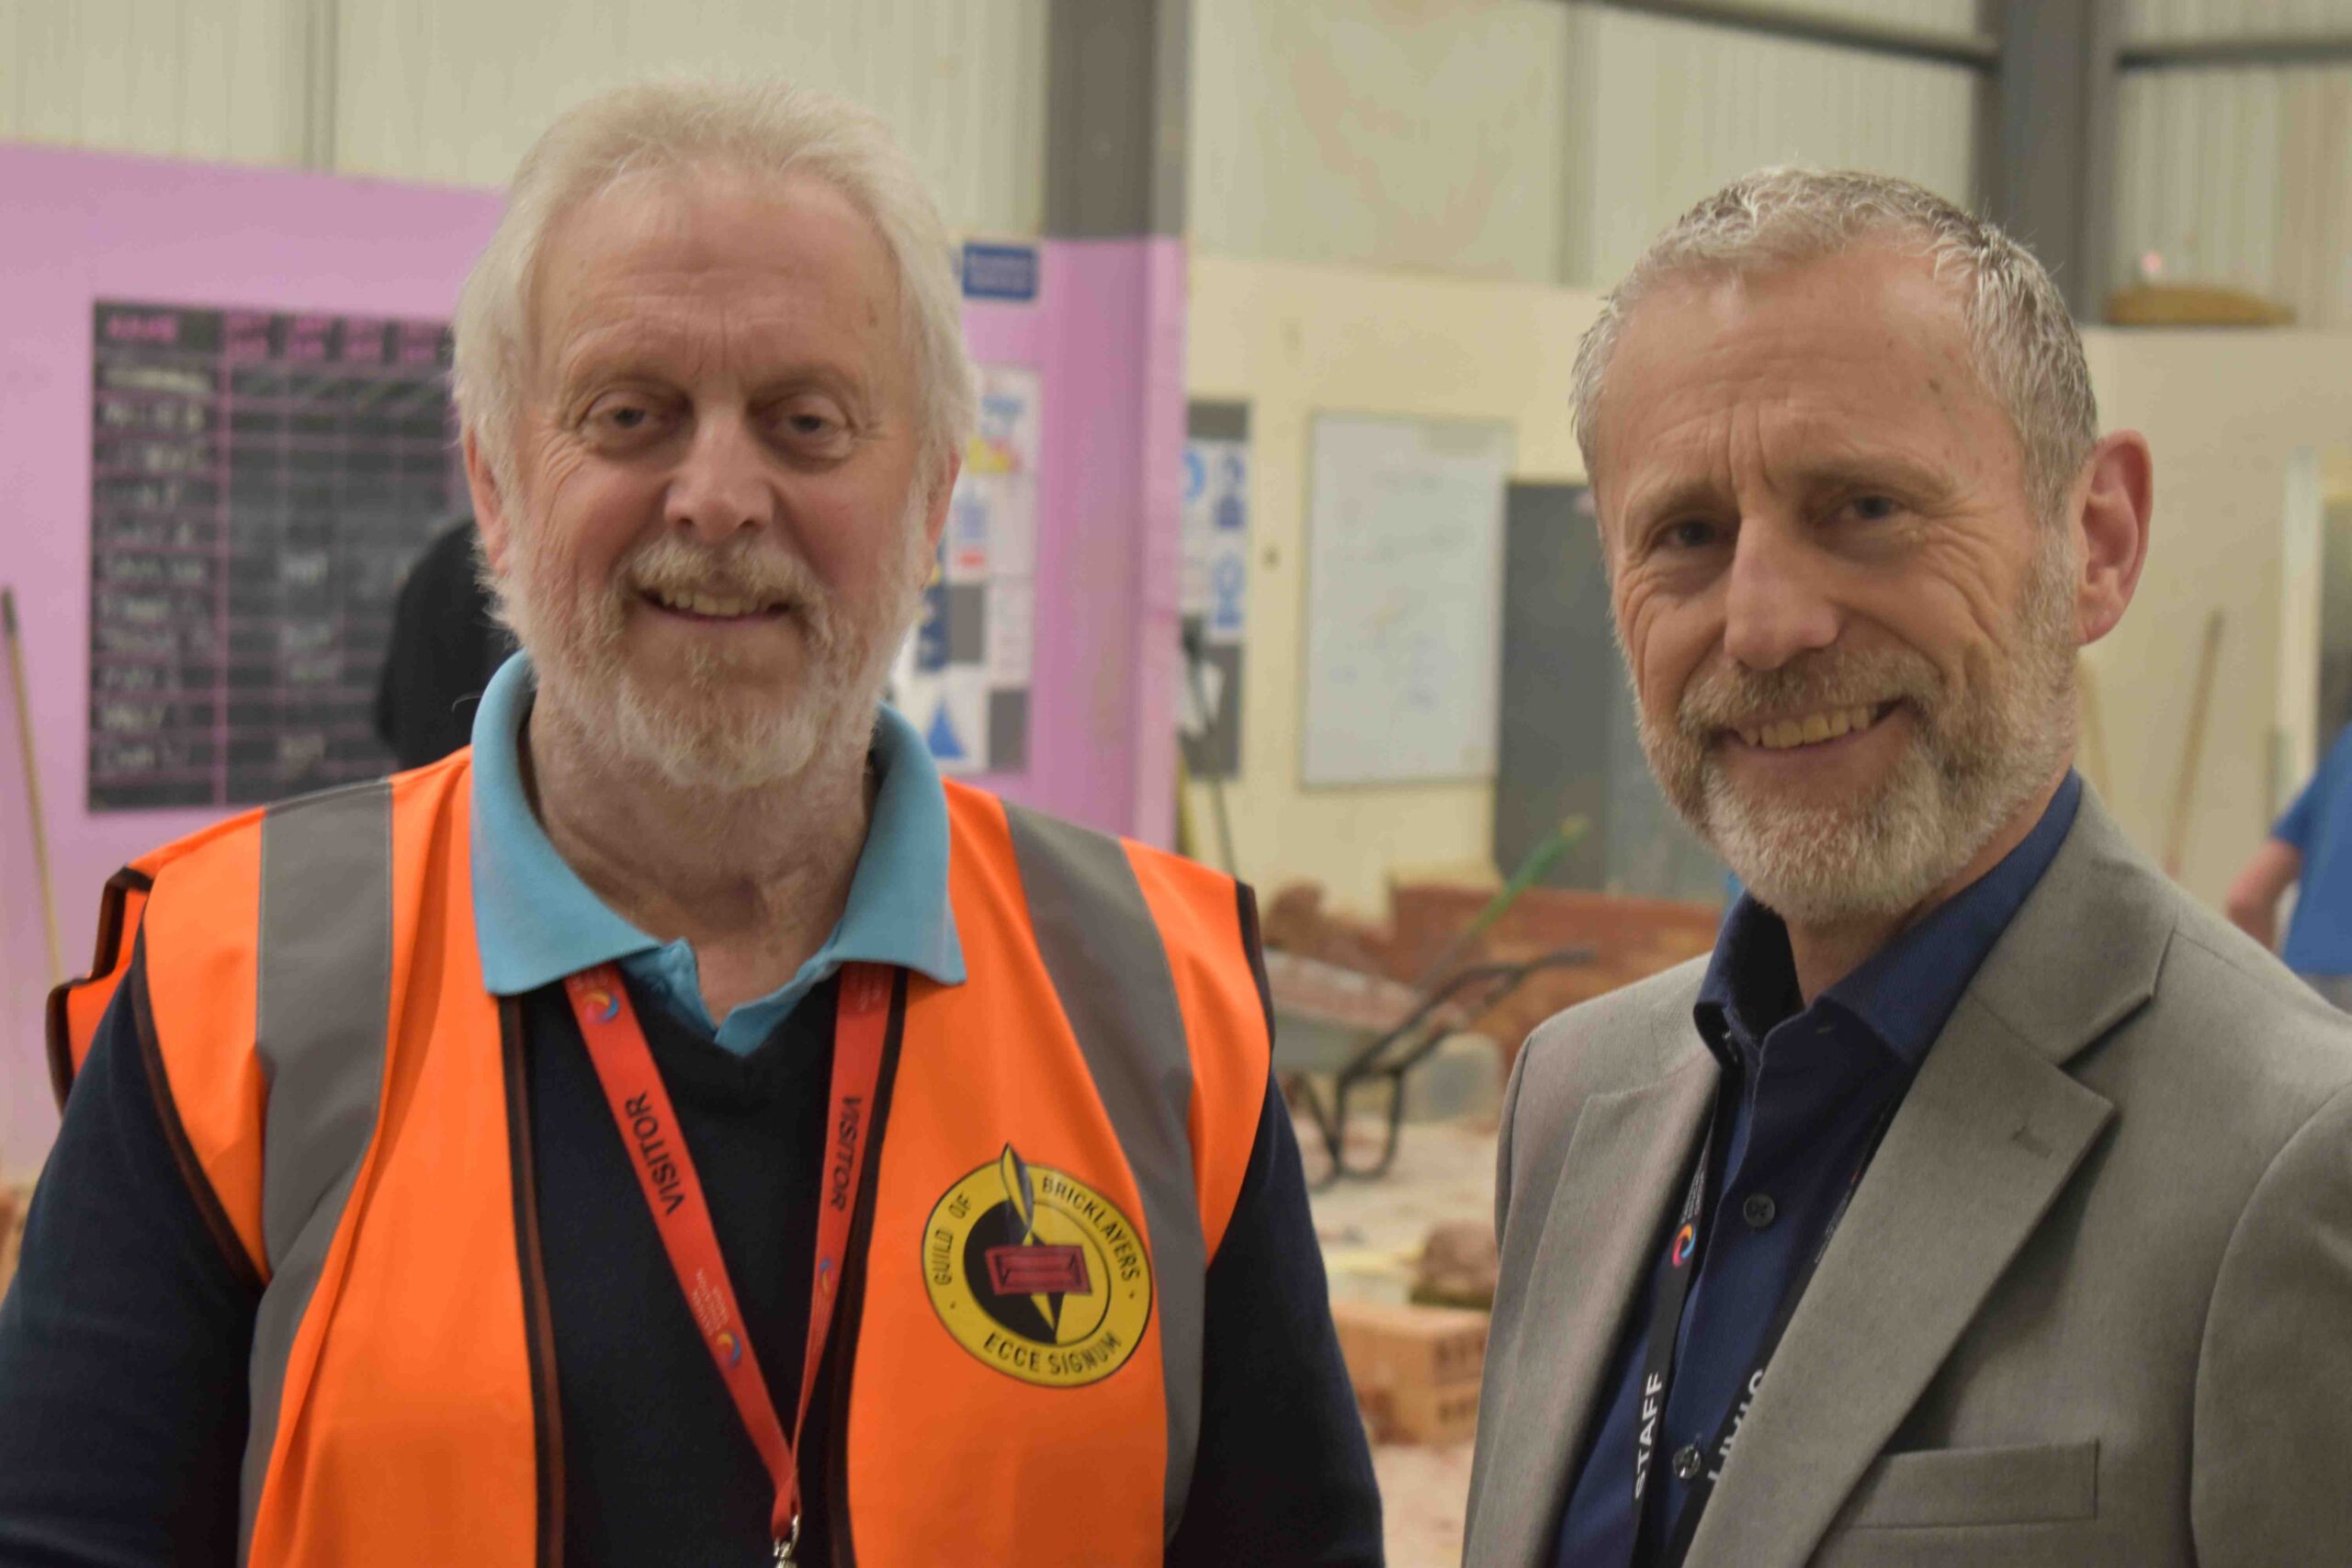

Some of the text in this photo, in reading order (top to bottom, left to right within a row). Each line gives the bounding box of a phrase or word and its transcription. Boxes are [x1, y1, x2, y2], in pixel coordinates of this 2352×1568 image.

[626, 1090, 685, 1215] VISITOR
[831, 1094, 862, 1213] VISITOR
[932, 1177, 1140, 1285] GUILD OF BRICKLAYERS
[983, 1331, 1122, 1375] ECCE SIGNUM
[1635, 1372, 1662, 1499] STAFF
